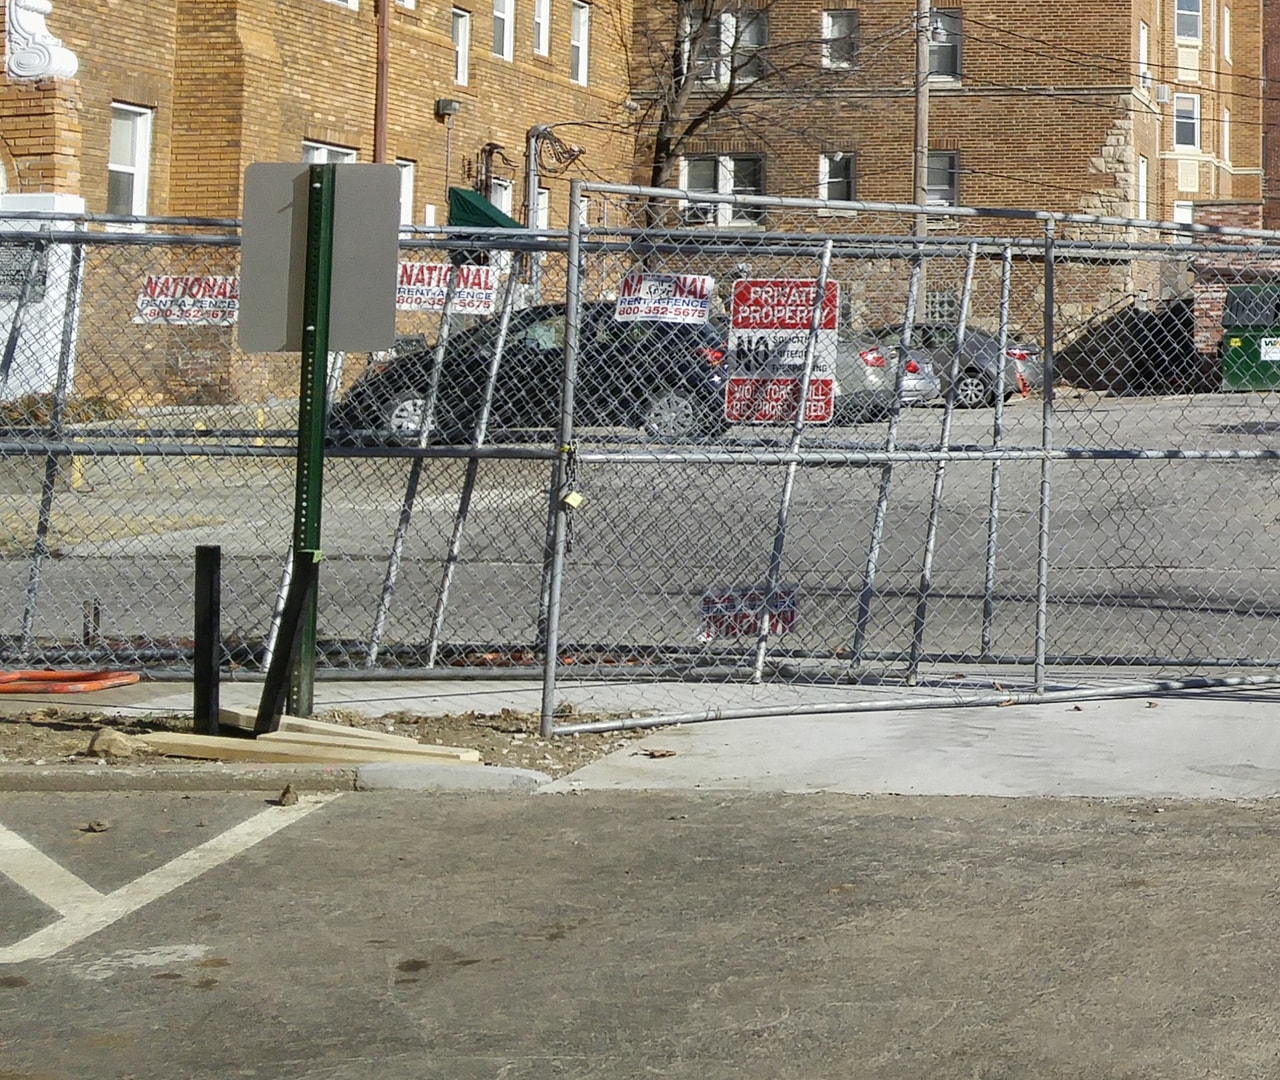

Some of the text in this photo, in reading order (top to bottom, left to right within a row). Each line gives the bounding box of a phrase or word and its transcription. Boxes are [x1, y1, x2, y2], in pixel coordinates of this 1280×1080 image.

[143, 276, 239, 299] NATIONAL
[397, 287, 492, 300] RENT-AENCE
[621, 275, 709, 300] NANAL
[396, 295, 491, 309] 800-35-5675
[620, 297, 709, 308] RENTA-FENCE
[750, 286, 818, 306] PRIVATE
[618, 306, 706, 318] 800-352-5675
[737, 306, 830, 325] PROPERY
[772, 364, 828, 373] TRESPAING
[754, 401, 826, 417] PROSTED
